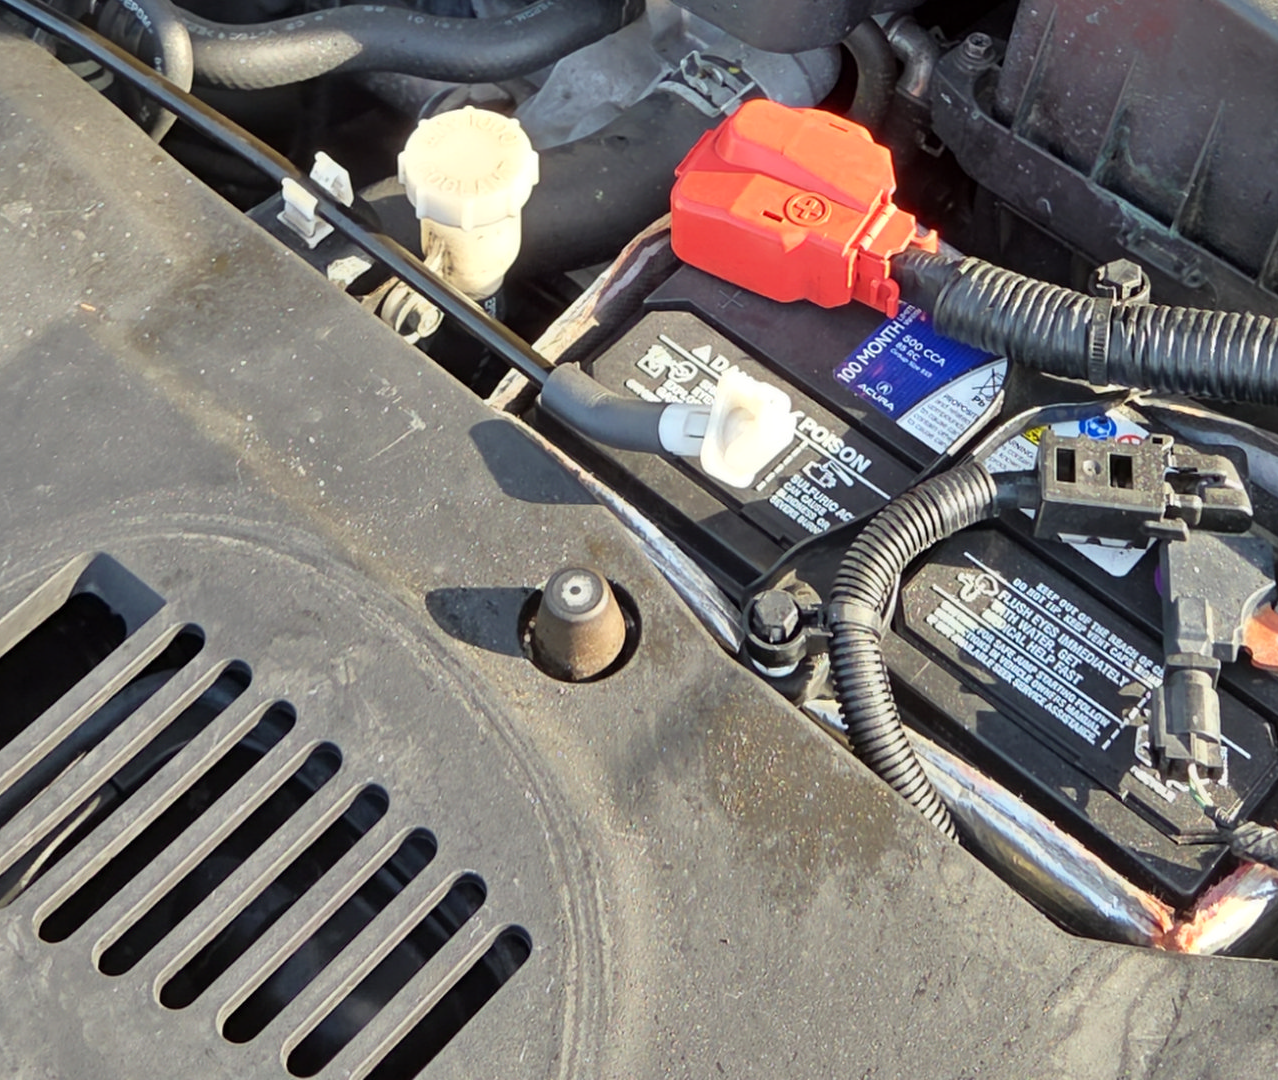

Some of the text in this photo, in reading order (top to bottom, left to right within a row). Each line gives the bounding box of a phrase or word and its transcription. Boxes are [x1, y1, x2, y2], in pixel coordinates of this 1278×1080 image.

[837, 320, 905, 384] 100 MONTH
[923, 348, 947, 368] CCA
[857, 383, 896, 412] ACURA
[971, 395, 986, 407] Pb
[798, 417, 872, 474] POISON
[769, 495, 800, 520] SEVERE
[775, 488, 831, 531] BLINDNESS OR
[783, 482, 828, 517] CAN CAUSE
[790, 474, 840, 513] SULFURIC
[991, 600, 1020, 624] TH
[1018, 620, 1055, 653] WATER.
[1057, 648, 1082, 668] GET
[998, 590, 1034, 618] FLUSH
[1031, 614, 1060, 638] EYES
[1057, 633, 1130, 688] IMMEDIATELY
[1012, 578, 1028, 591] DO
[1026, 587, 1046, 604] NOT
[1063, 615, 1087, 633] KEEP
[1086, 630, 1110, 649] VENT
[1036, 583, 1153, 669] KEEP OUT OF THE REACH OF
[981, 609, 1027, 647] DICAL
[1026, 641, 1056, 665] HELP
[1053, 660, 1084, 685] FAST
[951, 634, 1096, 746] AILABLE SEEK SERVICE ASSISTANCE.
[976, 628, 996, 644] FOR
[993, 639, 1017, 659] SAFE
[1013, 655, 1038, 674] JUMP
[1036, 669, 1077, 704] STARTING
[1075, 697, 1111, 728] FOLLOW
[999, 655, 1033, 683] VEHICLE
[1031, 679, 1067, 708] OWNERS
